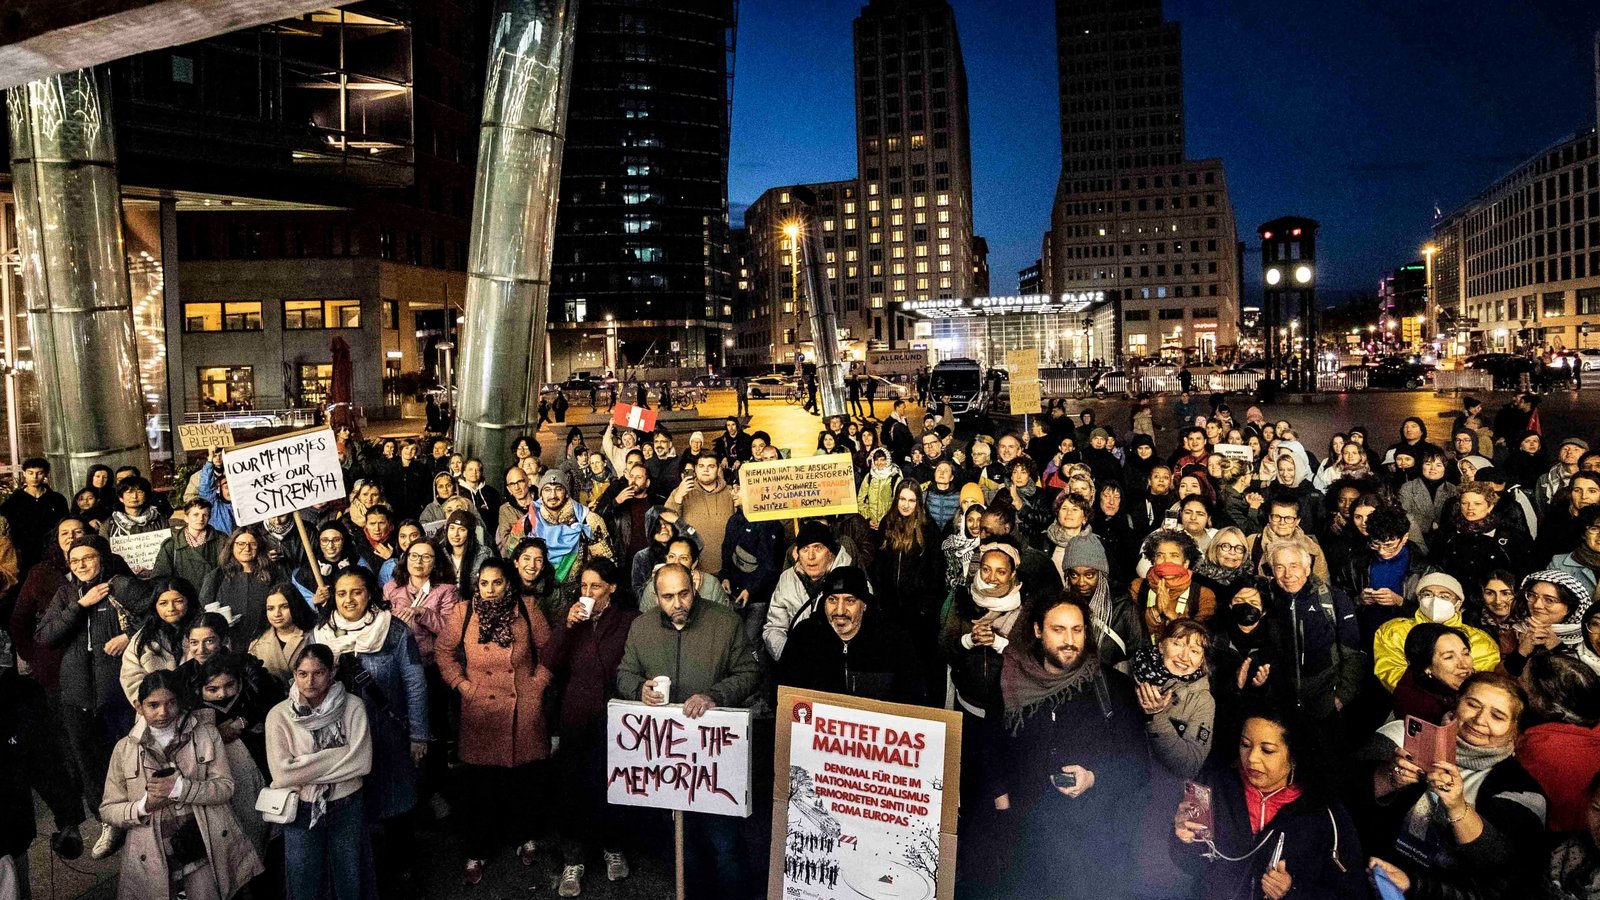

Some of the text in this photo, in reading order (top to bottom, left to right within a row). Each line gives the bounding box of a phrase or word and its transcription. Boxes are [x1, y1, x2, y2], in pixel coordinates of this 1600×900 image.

[902, 292, 1105, 310] BAHNHOF POTSDAMER PLATZ
[180, 424, 232, 437] DENKMAL
[189, 435, 231, 448] BLEIBT!
[232, 457, 261, 474] OUR
[251, 463, 315, 488] ARE OUR
[745, 462, 838, 477] NIEMAND HAT DIE ABSICHT
[254, 472, 337, 514] STRENGTH
[747, 477, 760, 485] EIN
[760, 492, 770, 501] IN
[616, 713, 688, 762] SAVE
[814, 716, 926, 751] RETTET DAS
[812, 734, 920, 769] MAHNMAL!
[823, 761, 921, 789] DENKMAL FÜR DIE IM
[814, 773, 930, 804] NATIONALSOZIALISMUS
[815, 785, 928, 817] ERMORDETEN SINTI UND
[831, 801, 909, 827] ROMA EUROPAS
